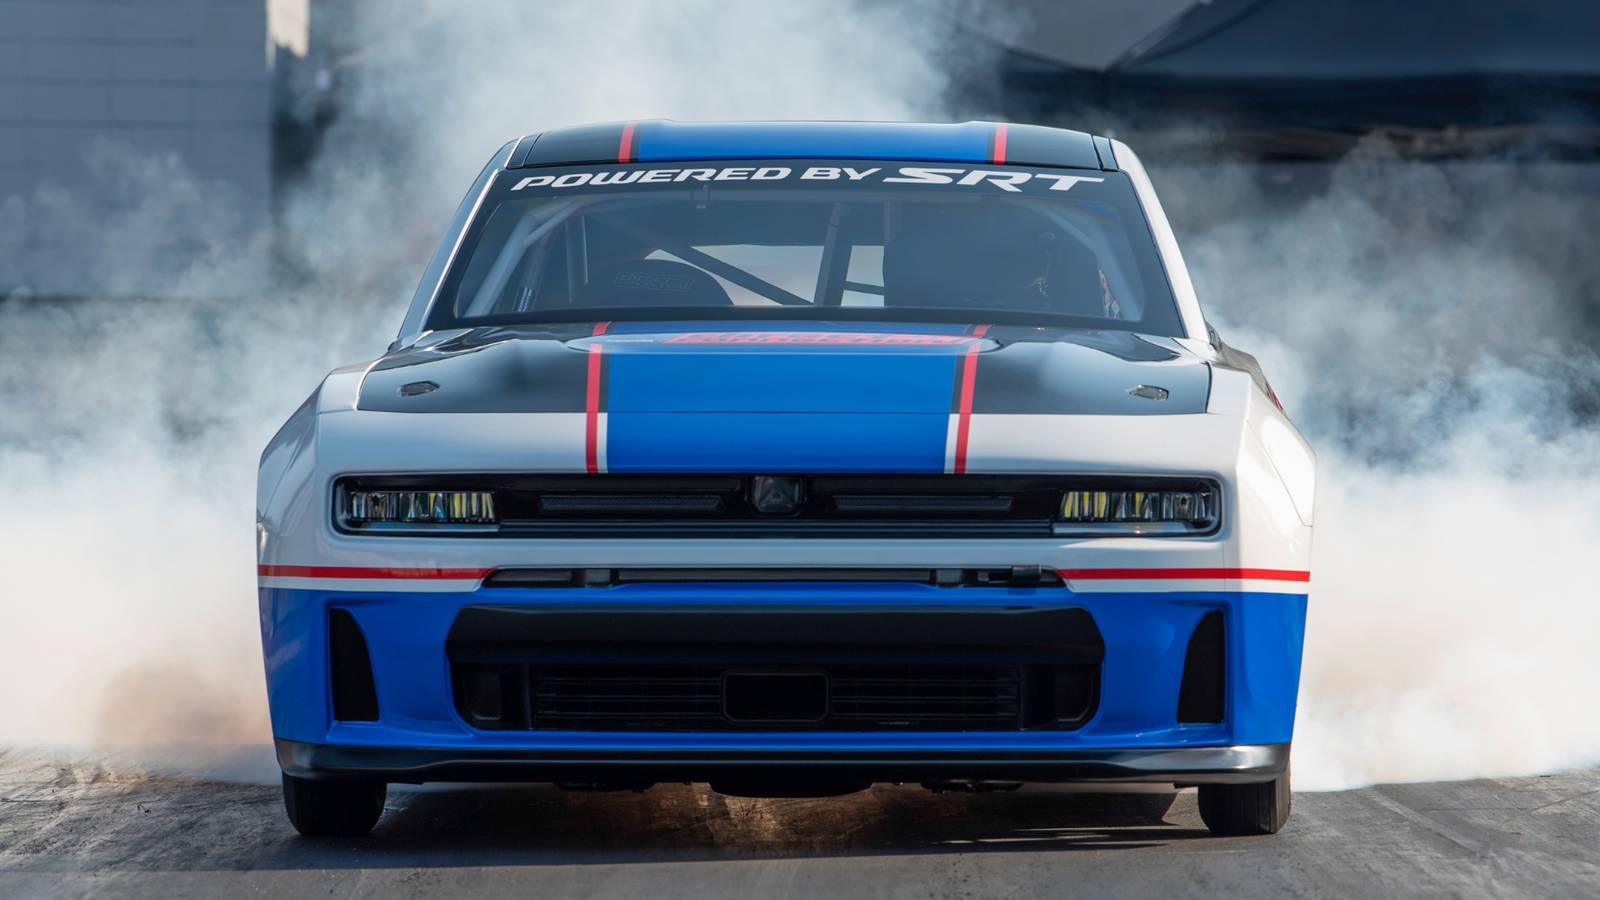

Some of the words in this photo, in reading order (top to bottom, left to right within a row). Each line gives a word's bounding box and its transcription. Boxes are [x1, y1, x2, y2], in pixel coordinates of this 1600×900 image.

[510, 167, 792, 191] POWERED
[800, 167, 882, 180] BY
[882, 167, 1105, 193] SRT
